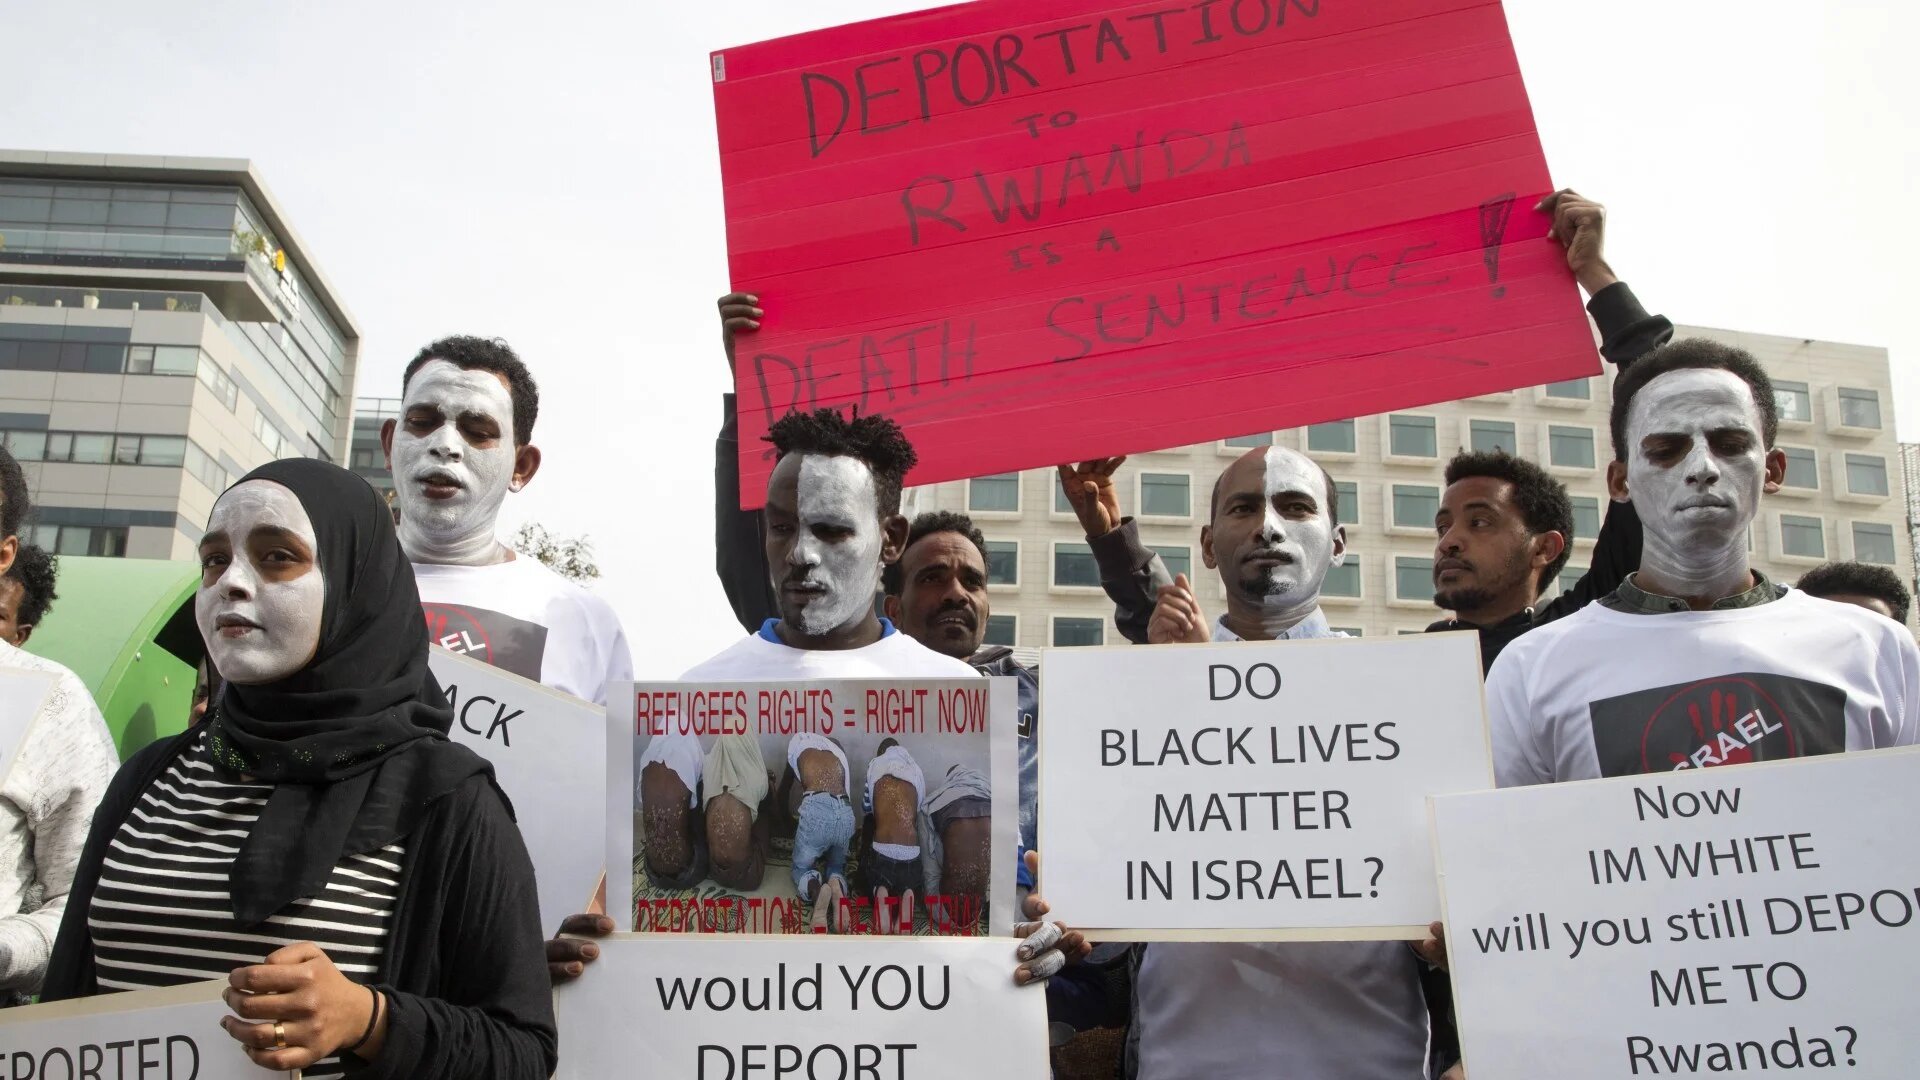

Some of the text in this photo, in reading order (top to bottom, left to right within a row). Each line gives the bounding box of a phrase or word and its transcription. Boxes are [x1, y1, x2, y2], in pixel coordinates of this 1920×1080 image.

[803, 0, 1320, 158] DEPORTATION
[1013, 110, 1078, 139] TO
[902, 120, 1253, 246] RWANDA
[1007, 228, 1121, 273] IS A
[754, 319, 977, 428] DEATH
[1209, 663, 1281, 700] DO
[638, 691, 746, 735] REFUGEES
[759, 690, 832, 734] RIGHTS
[843, 708, 856, 728] =
[866, 689, 928, 733] RIGHT
[939, 688, 987, 733] NOW
[1102, 722, 1399, 766] BLACK LIVES
[1155, 791, 1351, 831] MATTER
[1634, 786, 1740, 820] Now
[1127, 857, 1383, 900] IN ISRAEL?
[1589, 833, 1820, 884] IM WHITE
[1472, 888, 1920, 959] will you still DEPO
[656, 963, 949, 1011] would YOU
[1651, 962, 1806, 1007] ME TO
[0, 1035, 199, 1080] PORTED
[698, 1044, 917, 1080] DEPORT
[1627, 1026, 1857, 1074] Rwanda?
